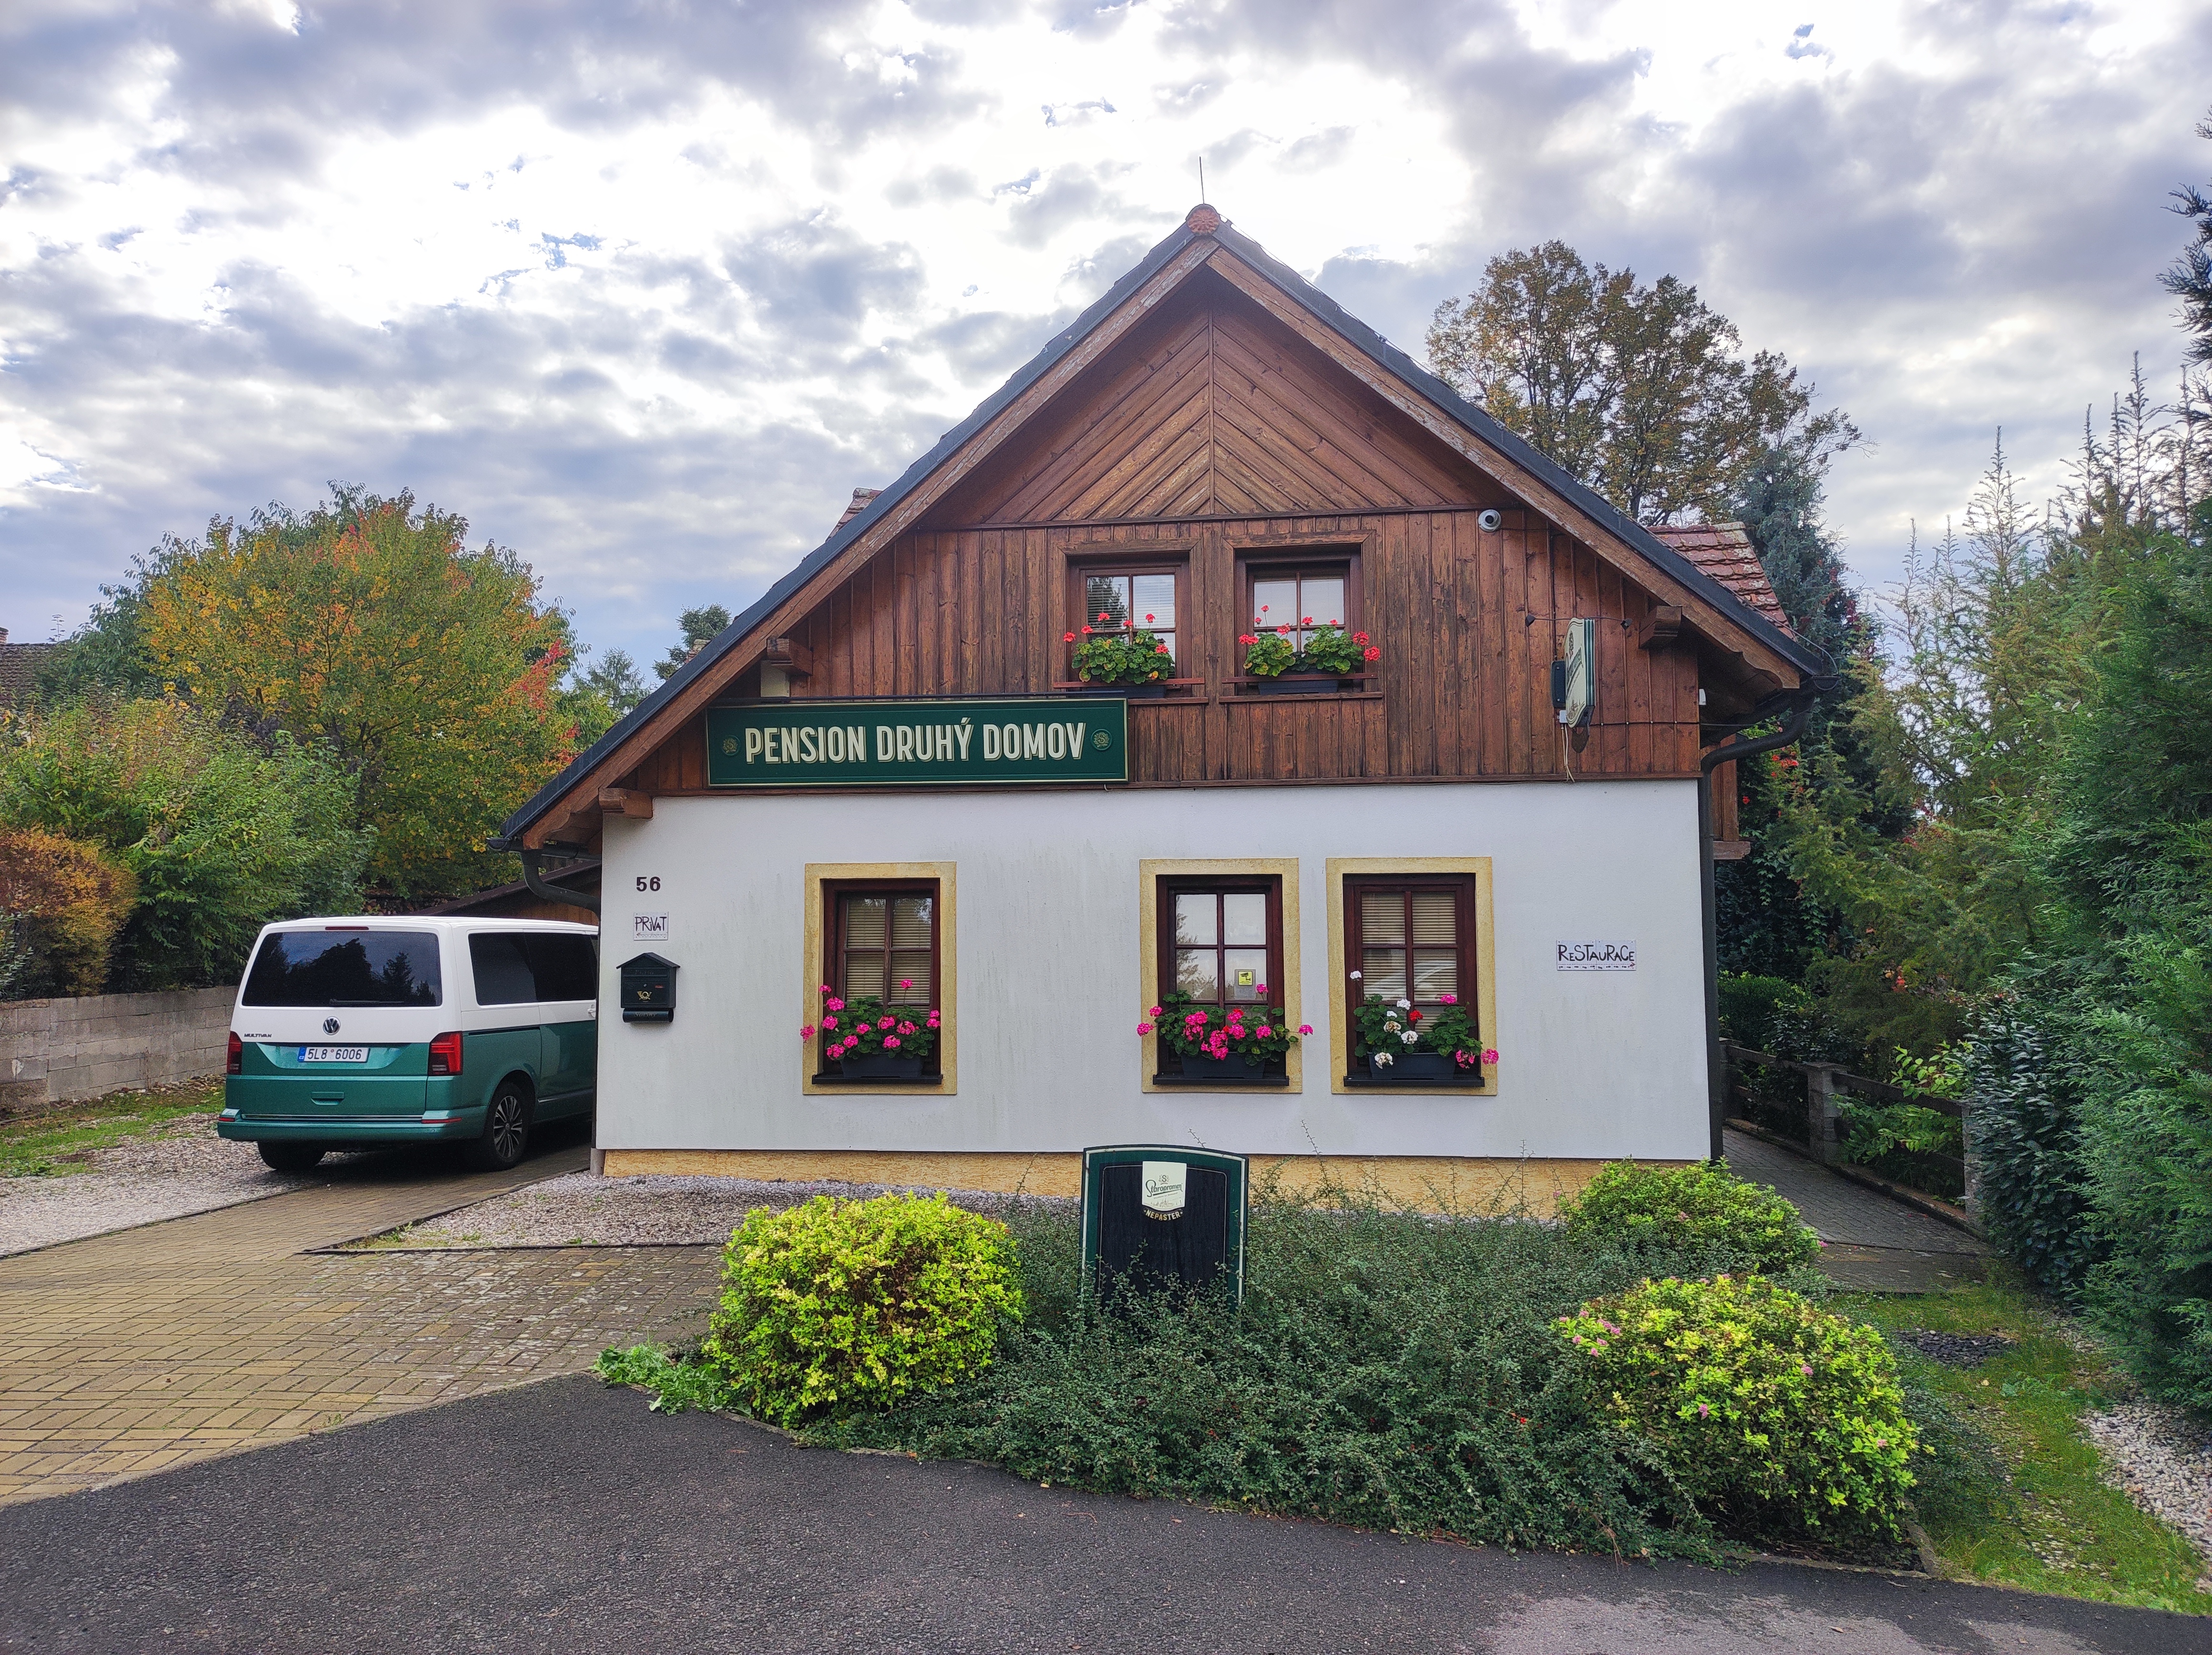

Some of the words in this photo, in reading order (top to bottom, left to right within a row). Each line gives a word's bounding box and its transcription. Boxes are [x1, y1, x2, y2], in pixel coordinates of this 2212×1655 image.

[745, 726, 867, 763] PENSION
[876, 717, 973, 762] DRUHÝ
[983, 722, 1086, 760] DOMOV
[636, 877, 661, 892] 56
[307, 1049, 328, 1060] 5L8
[335, 1049, 362, 1060] 6006
[1146, 1179, 1182, 1197] Staropramen
[1146, 1209, 1181, 1221] NEPASTER
